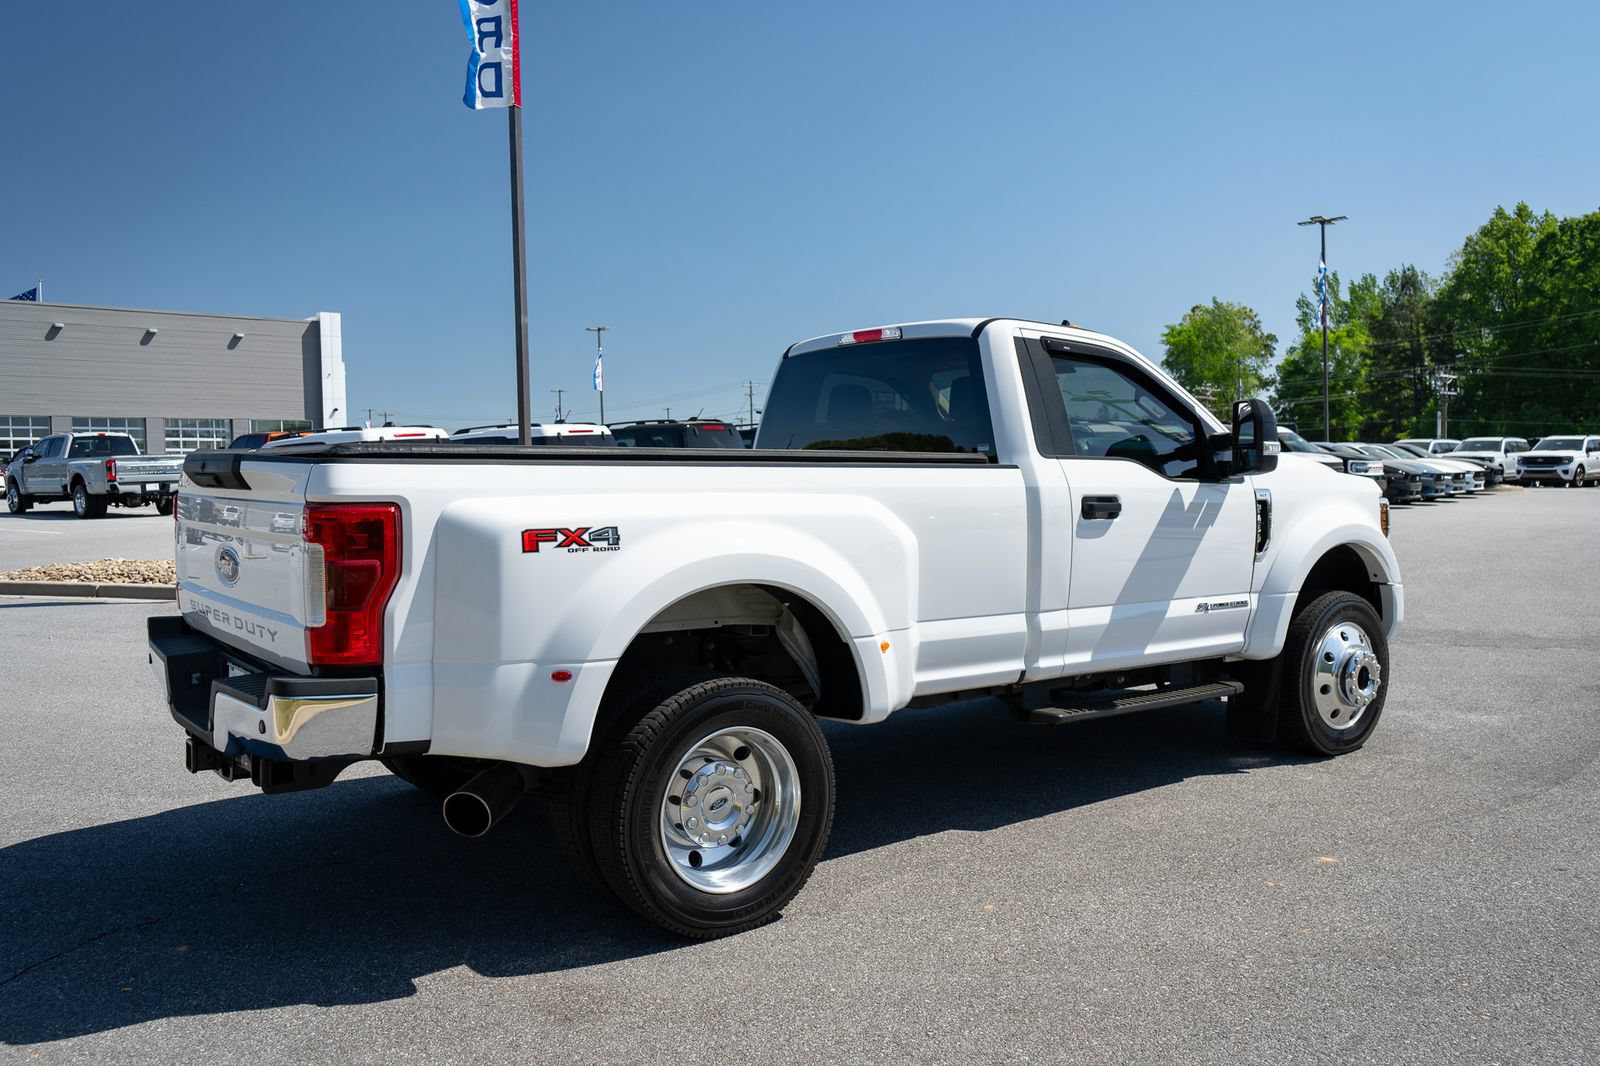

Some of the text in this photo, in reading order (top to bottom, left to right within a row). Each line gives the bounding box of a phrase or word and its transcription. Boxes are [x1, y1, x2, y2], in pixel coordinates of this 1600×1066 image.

[521, 526, 621, 553] FX4
[190, 599, 278, 642] SUPER DUTY
